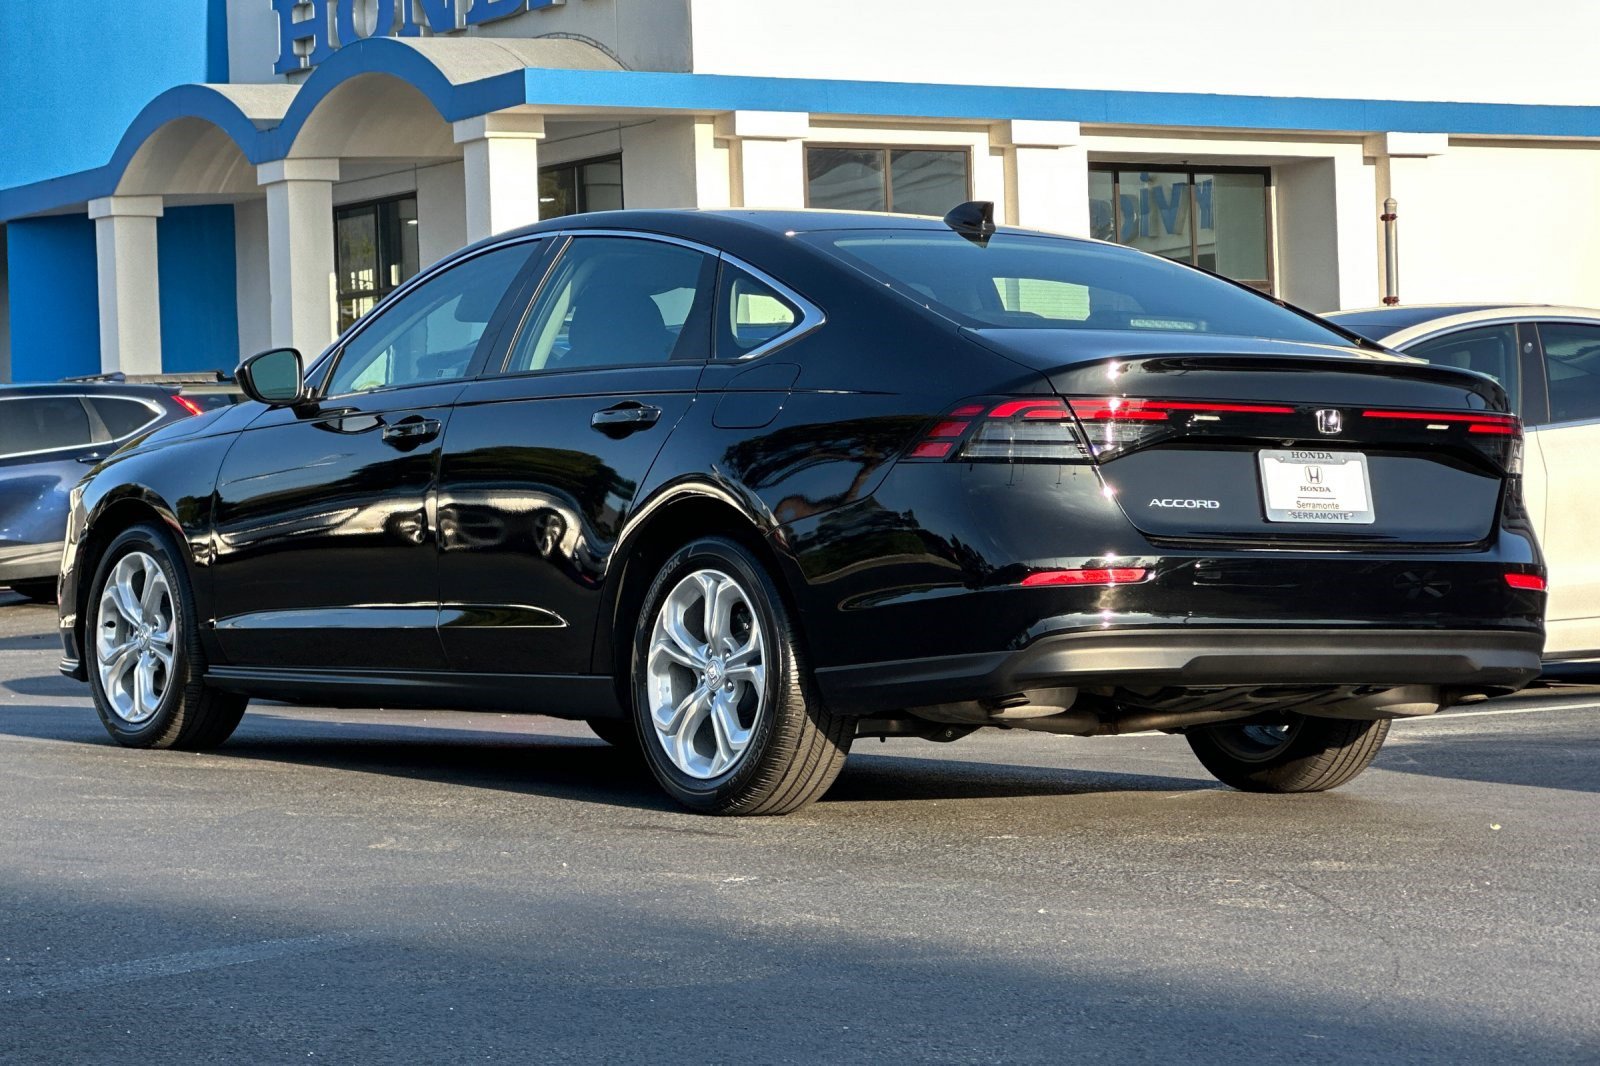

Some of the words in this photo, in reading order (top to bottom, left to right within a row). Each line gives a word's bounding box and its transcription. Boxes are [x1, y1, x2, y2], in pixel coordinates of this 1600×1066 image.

[271, 0, 560, 75] HON
[1291, 451, 1333, 460] HONDA
[1299, 485, 1332, 493] HONDA
[1148, 498, 1220, 509] ACCORD
[1296, 500, 1340, 509] Serramonte
[1291, 511, 1349, 520] SERRAMONTE
